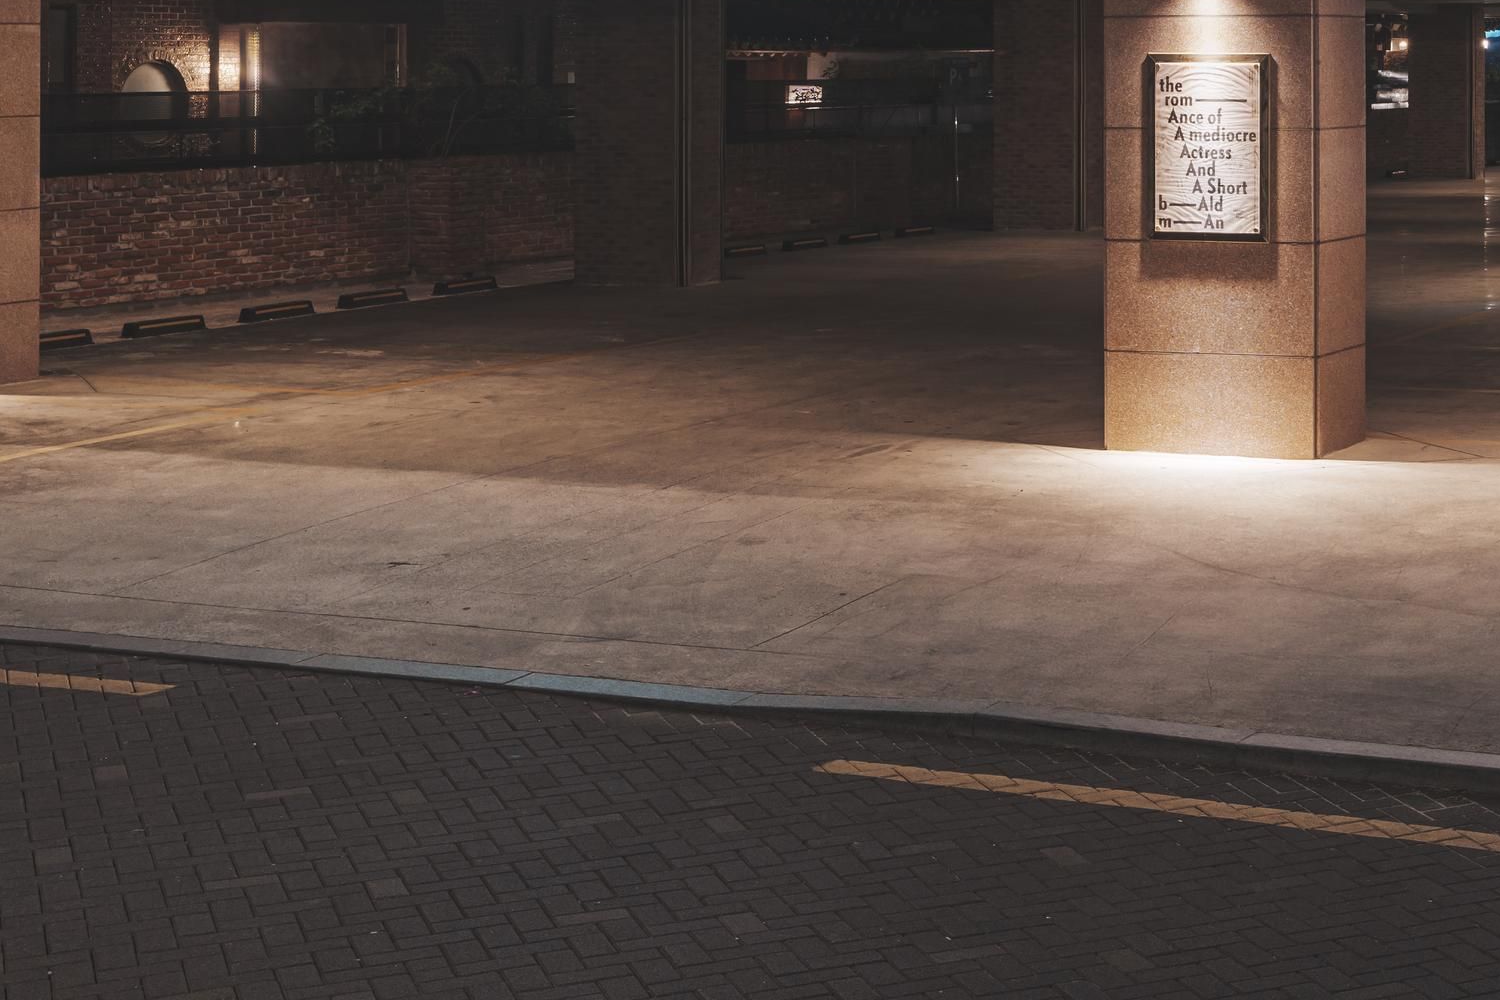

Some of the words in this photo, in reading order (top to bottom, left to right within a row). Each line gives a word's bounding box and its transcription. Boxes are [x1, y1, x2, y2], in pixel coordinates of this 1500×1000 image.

[1159, 76, 1183, 93] the
[1165, 95, 1193, 107] rom
[1168, 108, 1203, 124] Ance
[1208, 108, 1222, 124] of
[1174, 126, 1185, 141] A
[1189, 127, 1257, 142] mediocre
[1180, 143, 1232, 160] Actress
[1186, 161, 1216, 177] And
[1192, 179, 1203, 194] A
[1207, 178, 1248, 195] Short
[1159, 195, 1168, 211] b
[1197, 196, 1223, 212] Ald
[1159, 216, 1172, 228] m
[1204, 214, 1224, 229] An
